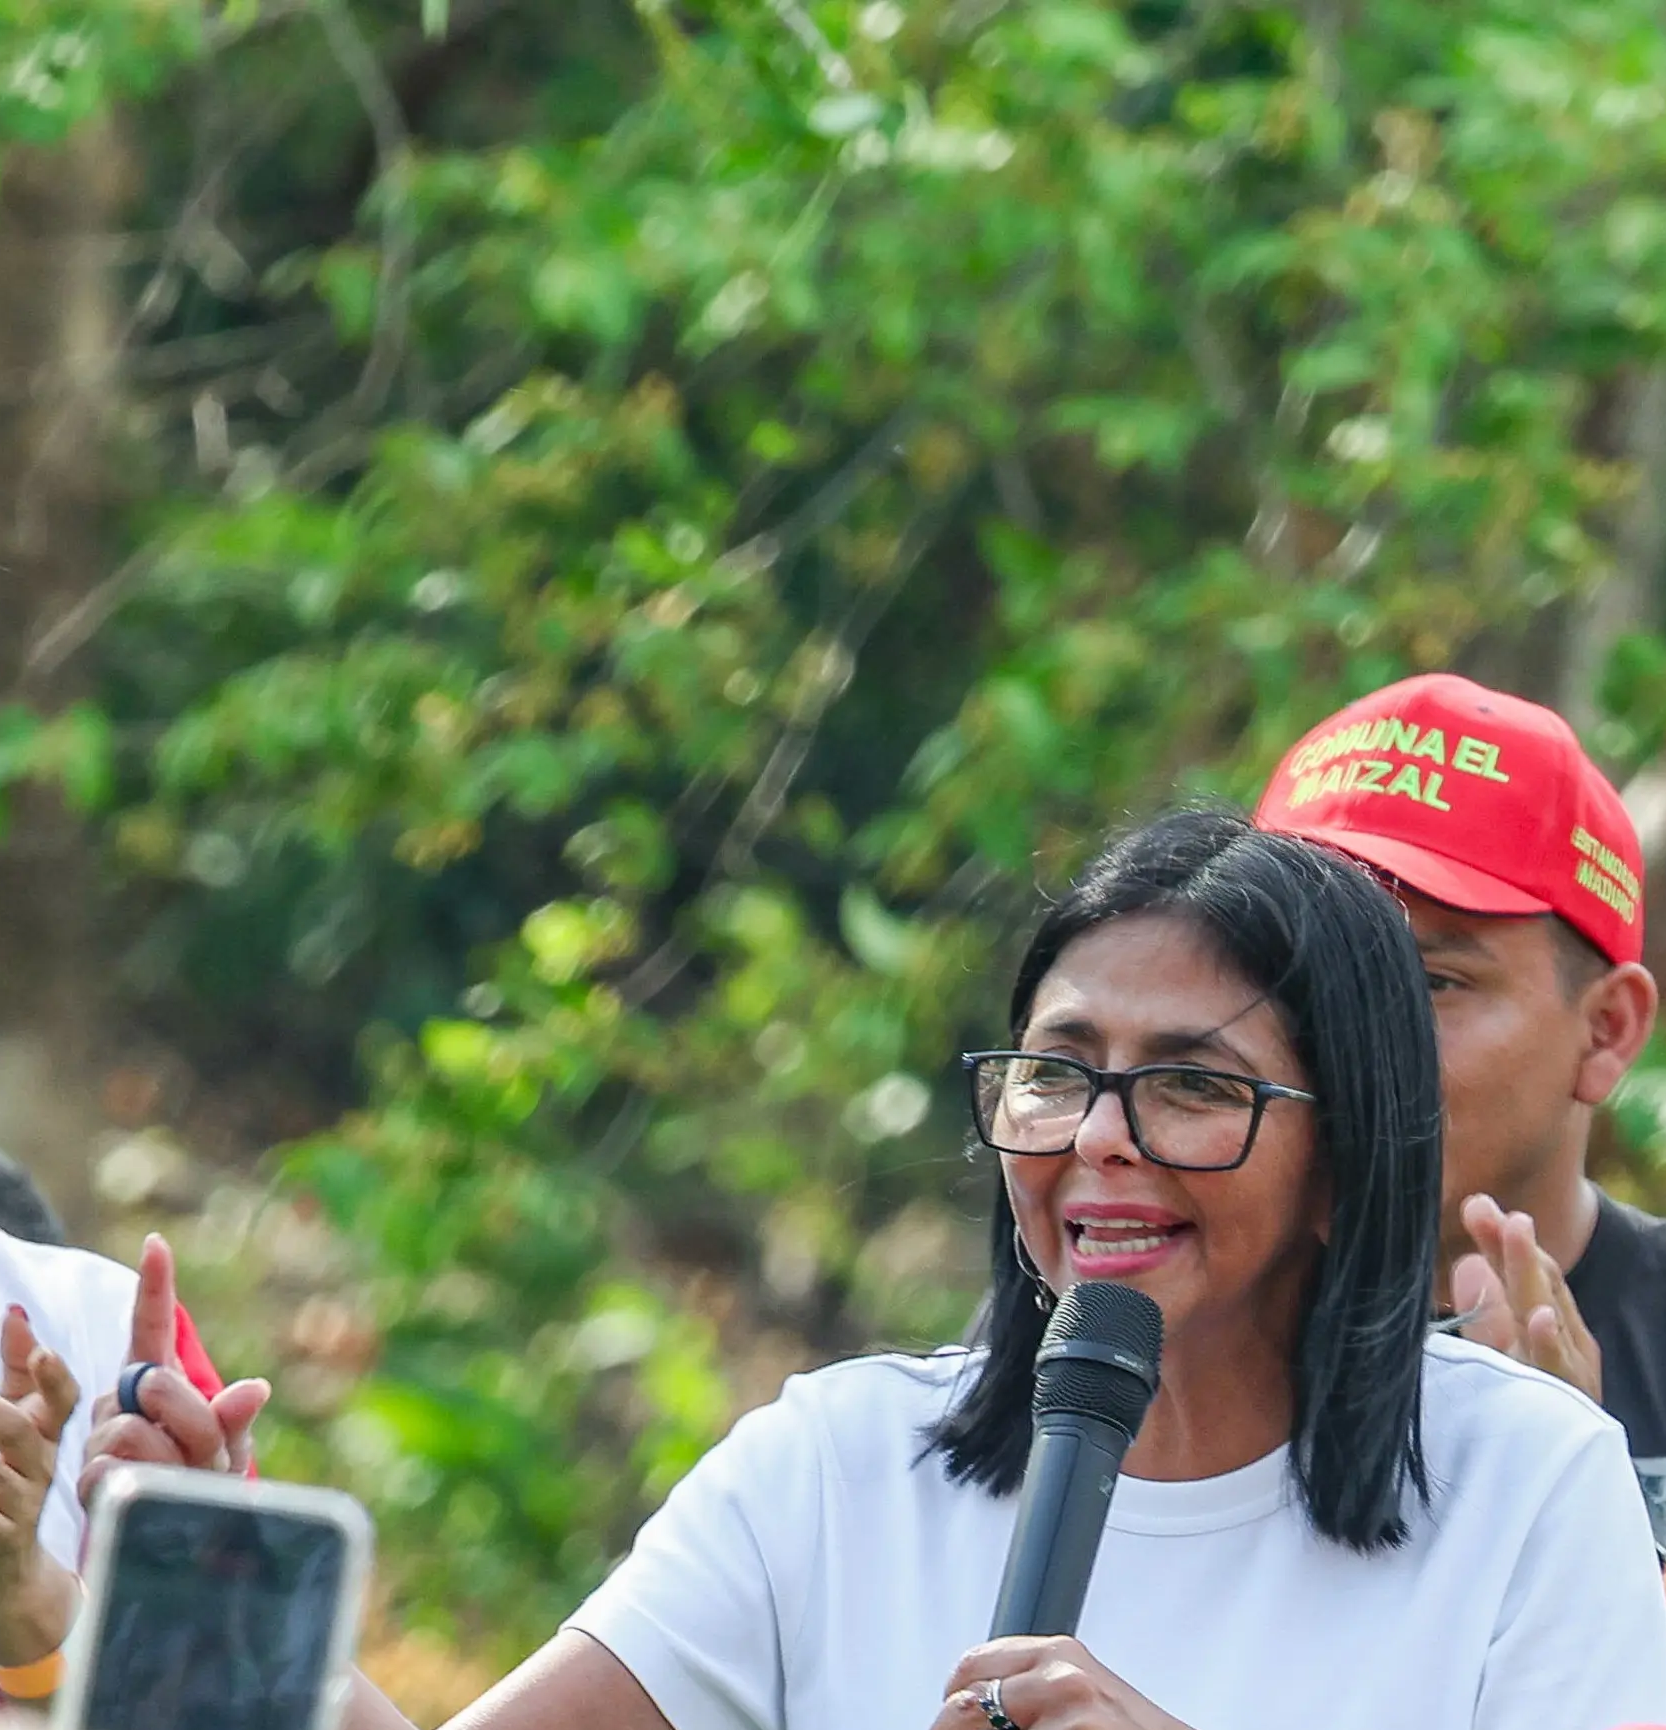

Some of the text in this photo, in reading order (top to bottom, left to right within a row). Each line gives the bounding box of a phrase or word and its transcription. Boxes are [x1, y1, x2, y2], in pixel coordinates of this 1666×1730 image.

[1288, 717, 1510, 783] COMUNA EL
[1286, 760, 1451, 811] MAIZAL
